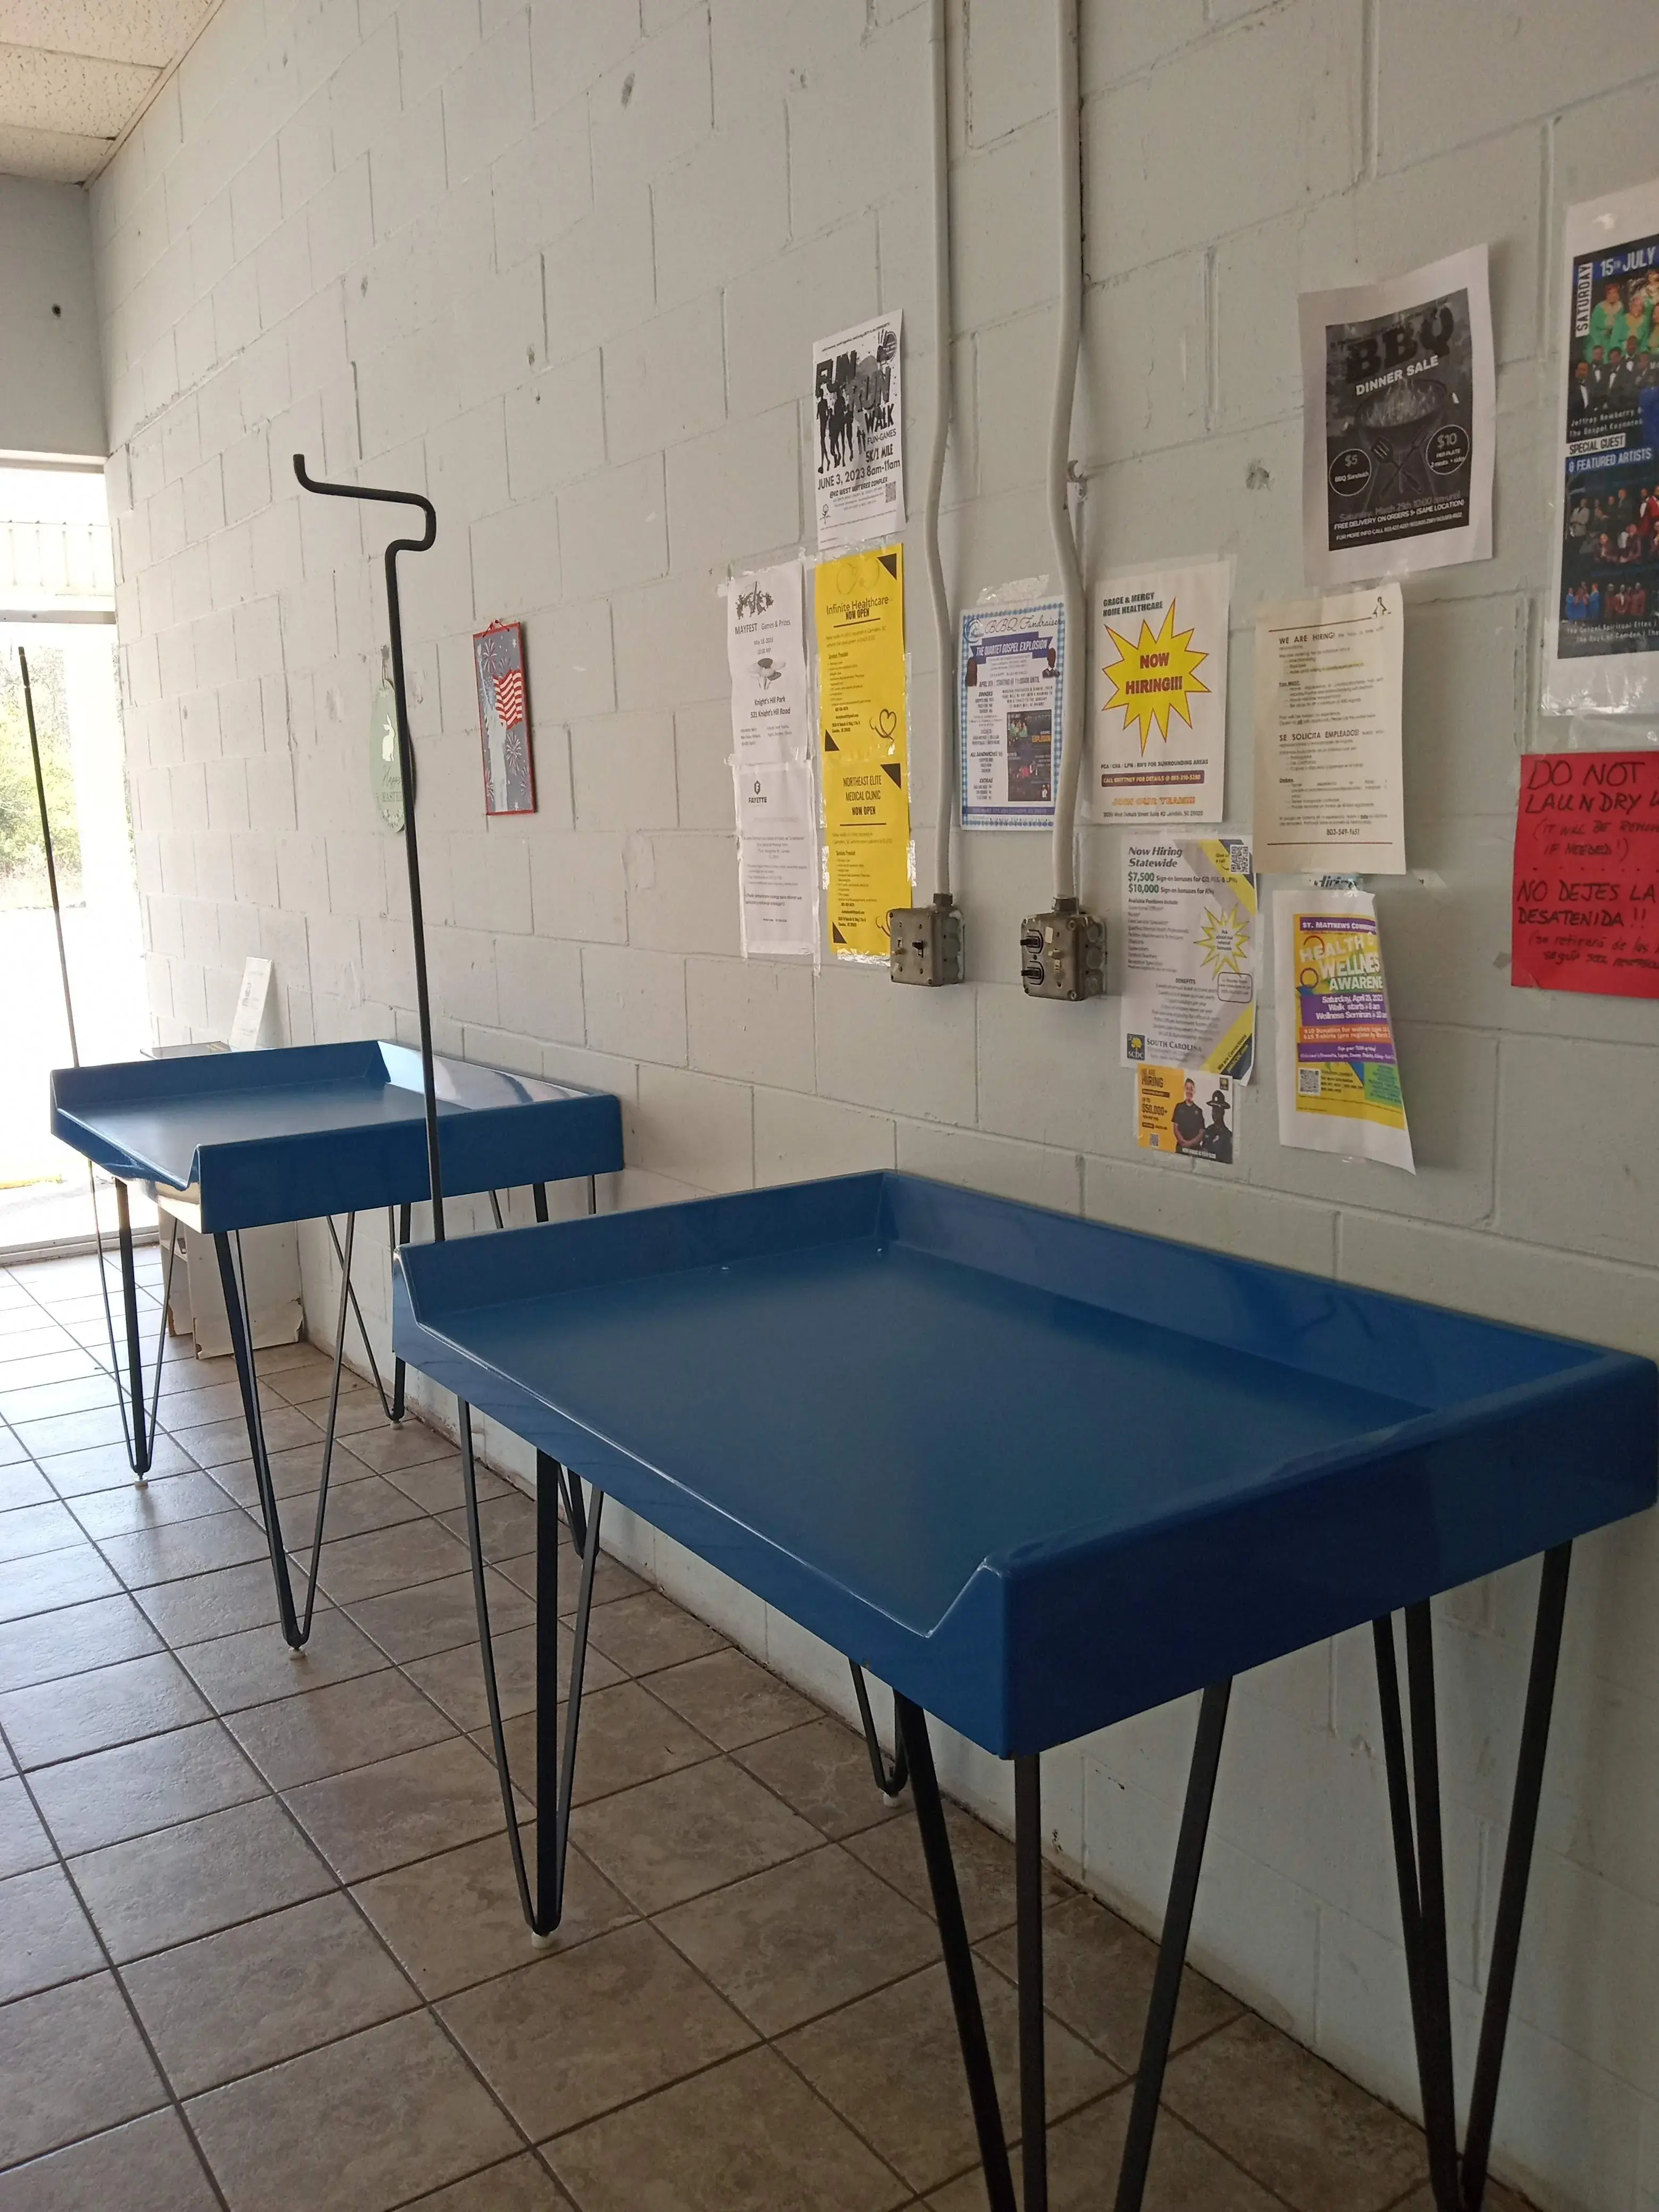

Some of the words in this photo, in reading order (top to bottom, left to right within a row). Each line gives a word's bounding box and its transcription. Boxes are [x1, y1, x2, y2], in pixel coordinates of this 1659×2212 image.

[1623, 246, 1656, 272] JULY
[1577, 265, 1591, 332] SATURDAY
[1346, 306, 1454, 383] BBQ
[815, 350, 857, 398] FUN
[1356, 369, 1403, 396] DINNER
[1406, 355, 1439, 376] SALE
[848, 366, 891, 413] RUN
[865, 403, 894, 434] WALK
[867, 429, 896, 445] FUN-GAMES
[1583, 425, 1607, 435] Gospel
[1437, 433, 1457, 449] $10
[1569, 440, 1599, 455] SPECIAL
[1601, 435, 1624, 449] GUEST
[866, 448, 879, 462] 5K/1
[881, 444, 893, 458] MILE
[1345, 455, 1358, 467] $5
[1577, 454, 1616, 471] FEATURED
[1618, 448, 1652, 464] ARTISTS
[818, 475, 834, 490] JUNE
[836, 474, 843, 485] 3,
[845, 467, 865, 482] 2023
[867, 459, 900, 476] 8am-11am
[1349, 517, 1376, 527] DELIVERY
[1387, 510, 1410, 521] ORDERS
[826, 603, 850, 615] Infinite
[852, 596, 889, 610] Healthcare
[1103, 597, 1124, 607] GRACE
[1132, 592, 1155, 602] MERCY
[845, 611, 856, 621] NOW
[857, 608, 869, 618] OPEN
[1103, 607, 1121, 617] HOME
[1122, 601, 1163, 614] HEALTHCARE
[735, 623, 757, 634] MAYFEST
[985, 617, 1018, 634] BBQ
[1002, 643, 1018, 653] GOSPEL
[1019, 640, 1048, 652] EXPLOSION
[1140, 652, 1170, 669] NOW
[1126, 676, 1183, 694] HIRING!!!
[843, 776, 869, 787] NORTHEAST
[870, 775, 882, 785] ELITE
[1526, 760, 1572, 790] DO
[1582, 762, 1645, 786] NOT
[845, 791, 865, 801] MEDICAL
[865, 790, 881, 800] CLINIC
[1525, 790, 1642, 815] LAUNDRY
[852, 807, 862, 815] NOW
[864, 806, 876, 815] OPEN
[1128, 847, 1151, 856] Now
[1152, 847, 1183, 858] Hiring
[1128, 858, 1178, 867] Statewide
[1128, 871, 1154, 883] $7,500
[1128, 884, 1159, 894] $10,000
[1516, 879, 1548, 902] NO
[1559, 879, 1620, 902] DEJES
[1630, 884, 1656, 904] LA
[1518, 907, 1624, 928] DESATENIDA
[1299, 935, 1364, 962] HEALTH
[1319, 952, 1380, 979] WELLNES
[1329, 976, 1383, 991] AWARENE
[1352, 994, 1364, 1003] April
[1146, 1038, 1168, 1048] SOUTH
[1169, 1041, 1202, 1052] CAROLINA
[1142, 1076, 1163, 1088] HIRING
